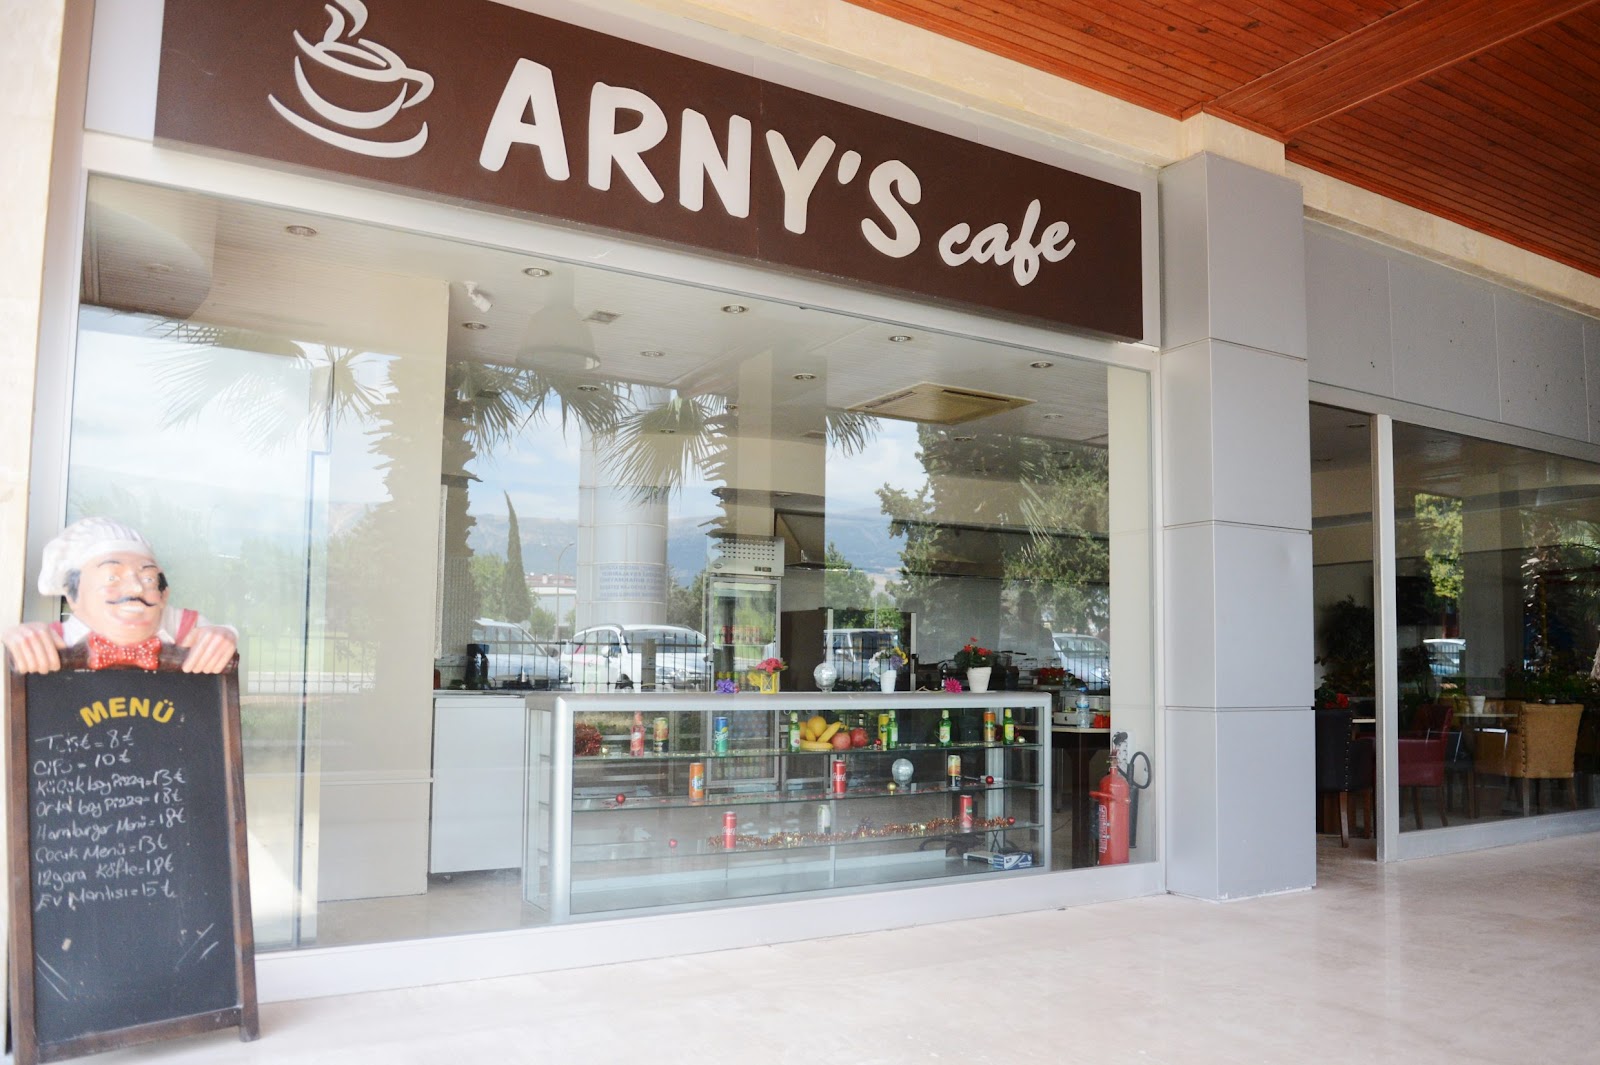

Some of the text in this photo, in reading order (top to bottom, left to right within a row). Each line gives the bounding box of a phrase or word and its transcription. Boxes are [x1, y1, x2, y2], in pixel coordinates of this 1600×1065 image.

[479, 57, 1076, 287] ARNY'S cafe
[79, 697, 175, 728] MENÜ
